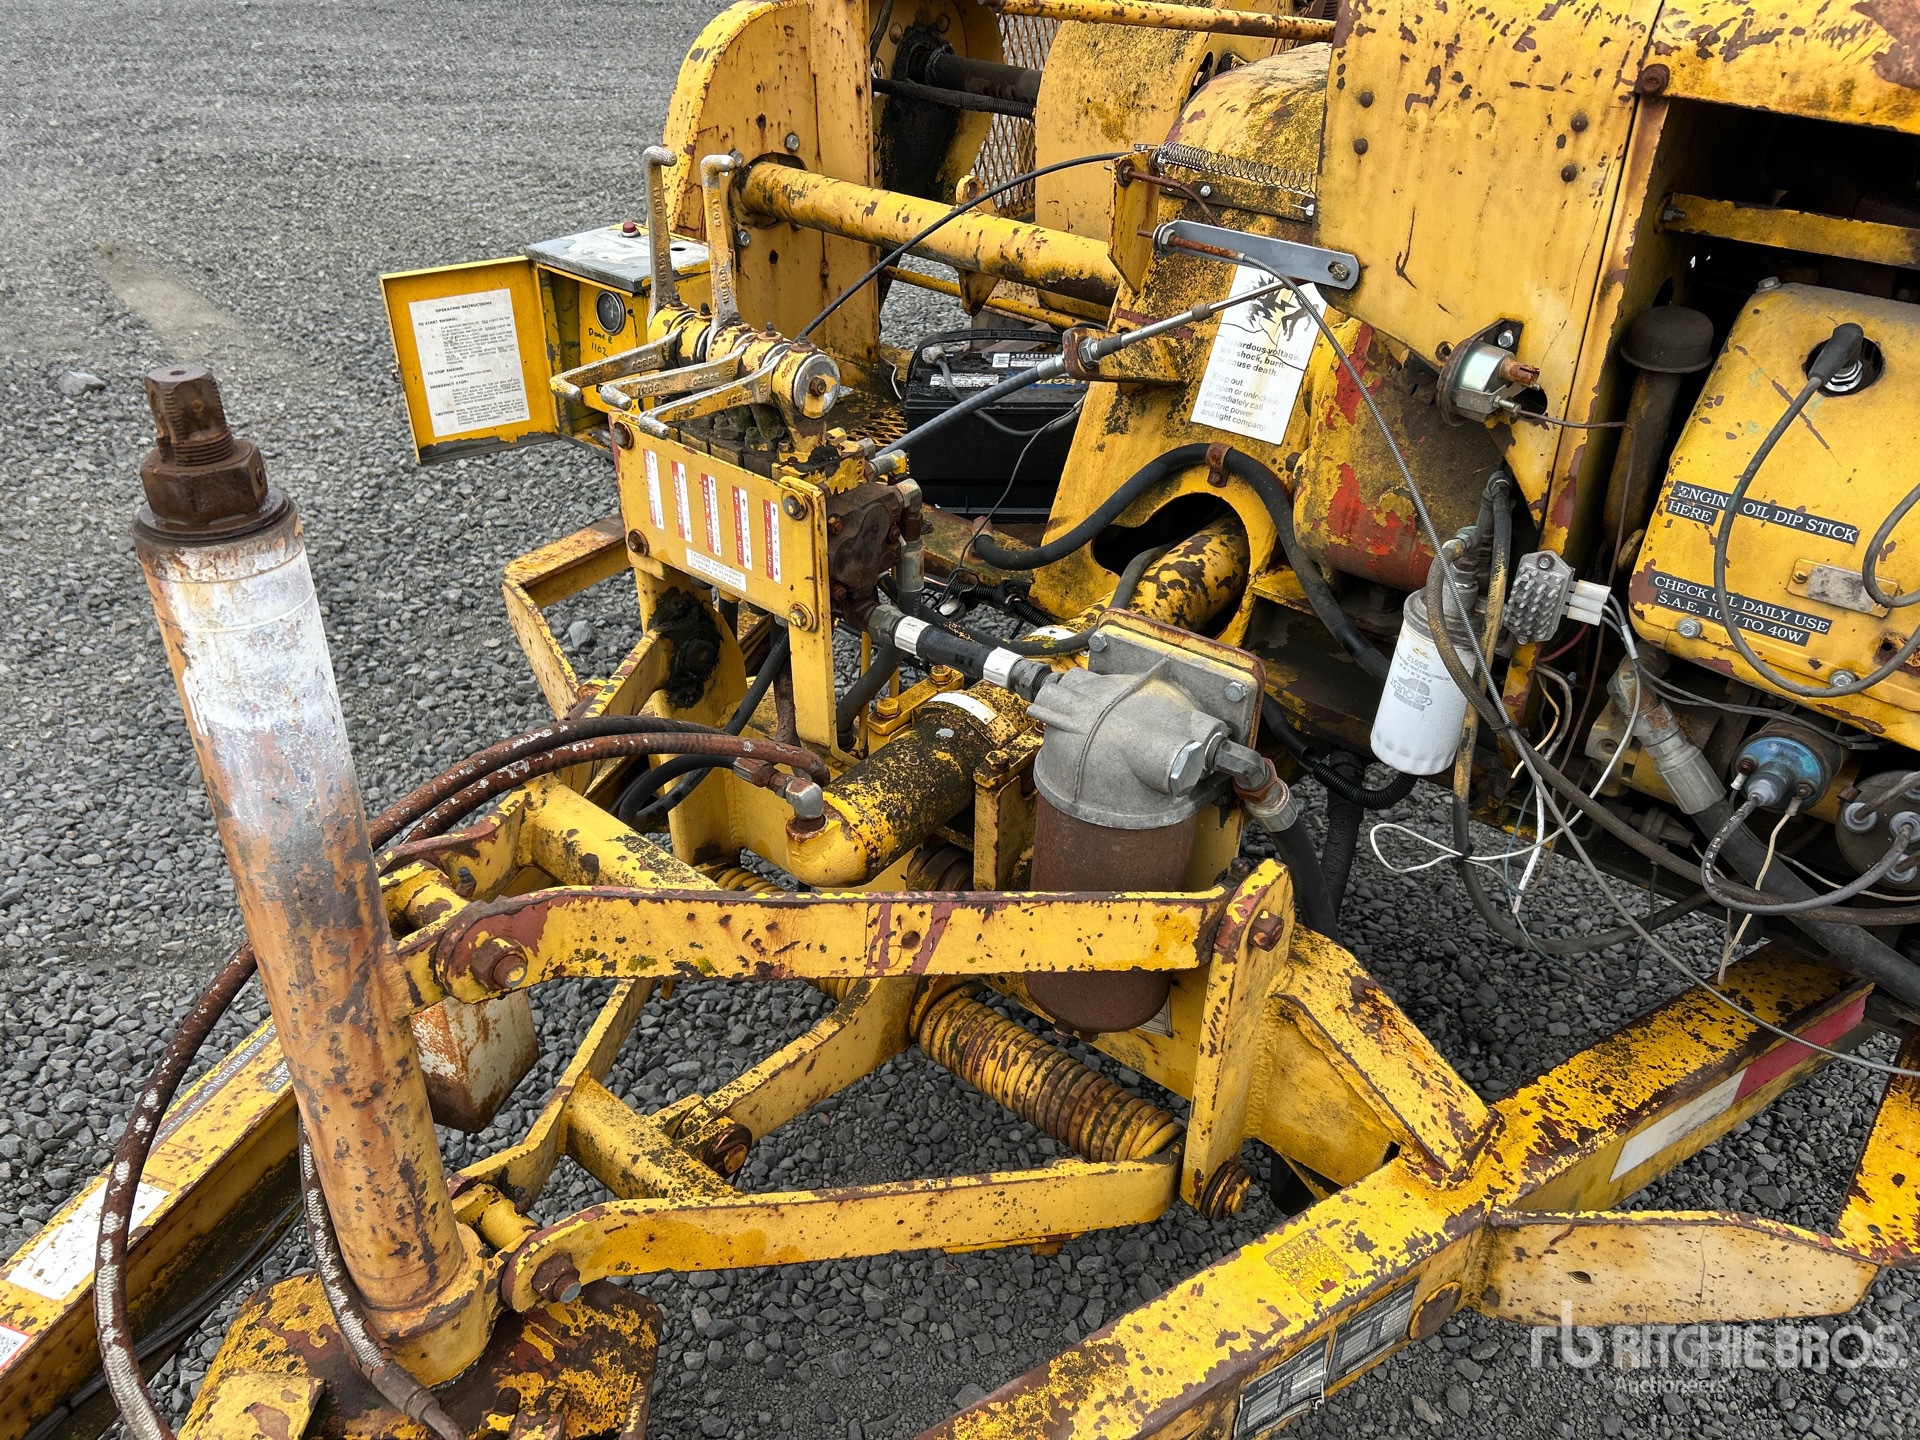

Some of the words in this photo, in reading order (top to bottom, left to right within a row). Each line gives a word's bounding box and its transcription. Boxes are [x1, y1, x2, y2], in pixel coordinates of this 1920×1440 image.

[1230, 407, 1253, 418] power
[1667, 500, 1713, 523] HERE
[1677, 485, 1730, 508] ENGIN
[1742, 502, 1771, 519] OIL
[1773, 510, 1804, 527] DIP
[1805, 518, 1858, 542] STICK
[1654, 576, 1708, 600] CHECK
[1711, 589, 1739, 608] OL
[1741, 599, 1791, 622] DAILY
[1793, 615, 1830, 633] USE
[1657, 593, 1700, 614] S.A.E.
[1742, 616, 1764, 632] TO
[1767, 625, 1804, 643] 40W
[1407, 653, 1429, 671] 85512
[1390, 677, 1433, 706] CARQUEST
[200, 1039, 263, 1098] EMERGENCY
